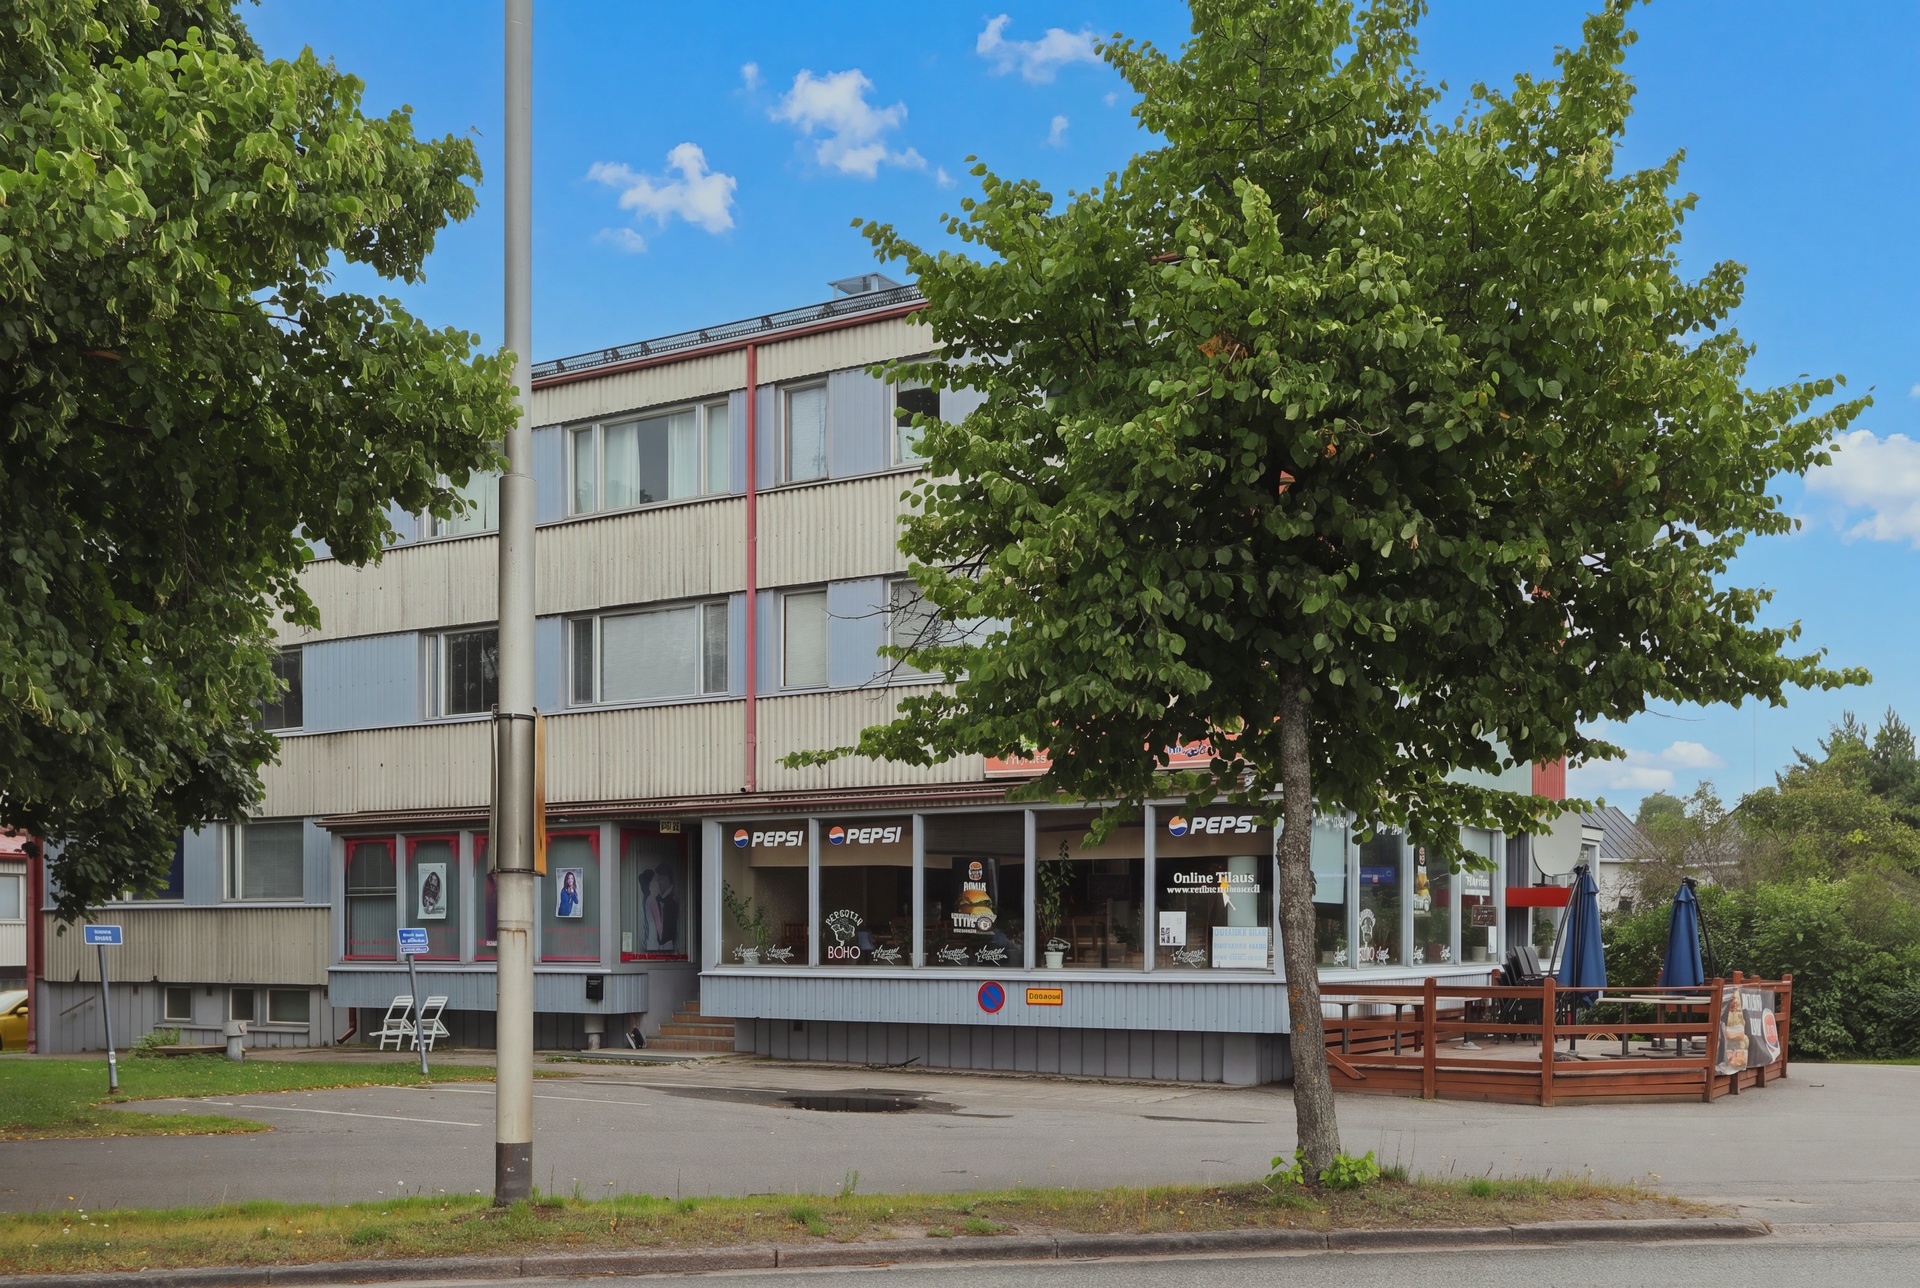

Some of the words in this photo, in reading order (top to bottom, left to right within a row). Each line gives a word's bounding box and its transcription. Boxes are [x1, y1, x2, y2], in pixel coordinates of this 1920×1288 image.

[751, 830, 803, 848] PEPSI
[846, 826, 902, 844] PEPSI
[1173, 872, 1213, 884] Online
[1215, 871, 1255, 884] Tilaus
[827, 945, 861, 960] BOHO
